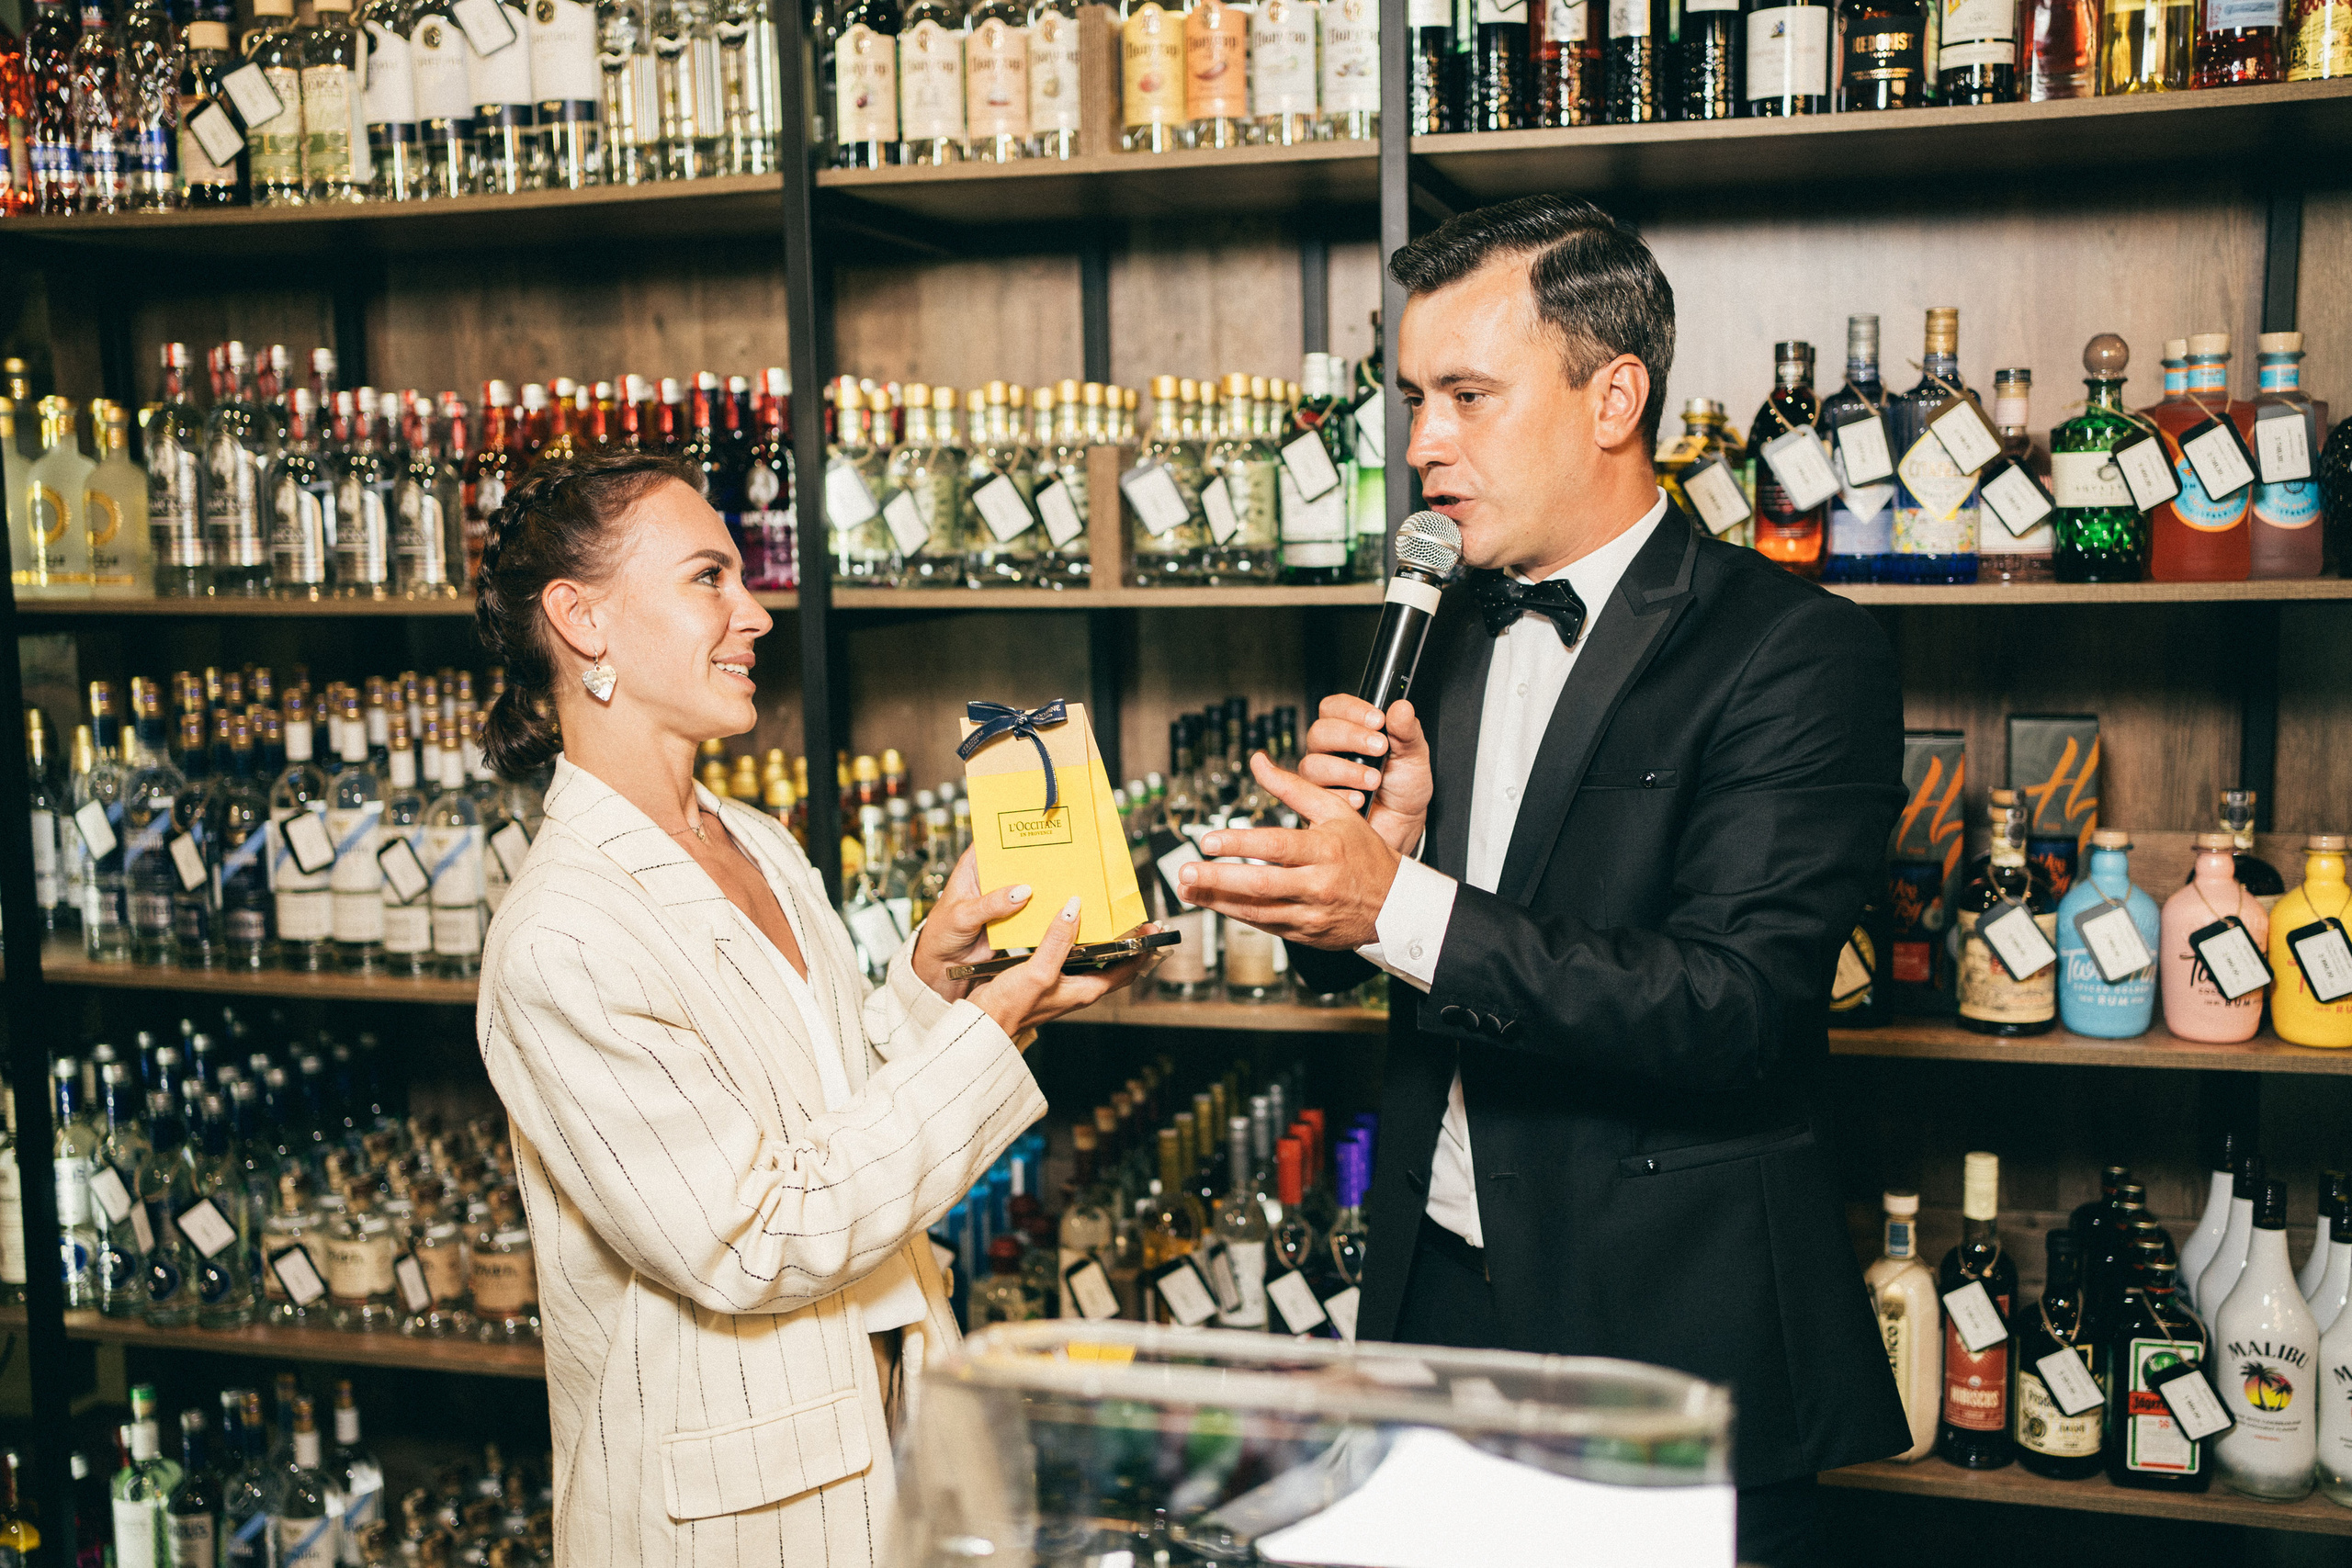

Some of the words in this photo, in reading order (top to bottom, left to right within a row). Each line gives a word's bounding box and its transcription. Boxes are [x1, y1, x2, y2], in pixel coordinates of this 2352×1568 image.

[1852, 32, 1915, 53] HEDONIST
[1009, 819, 1062, 832] L'OCCITANE
[2098, 995, 2129, 1008] RUM
[2225, 998, 2251, 1008] RUM
[2336, 1005, 2352, 1015] RU
[2227, 1340, 2310, 1370] MALIBU
